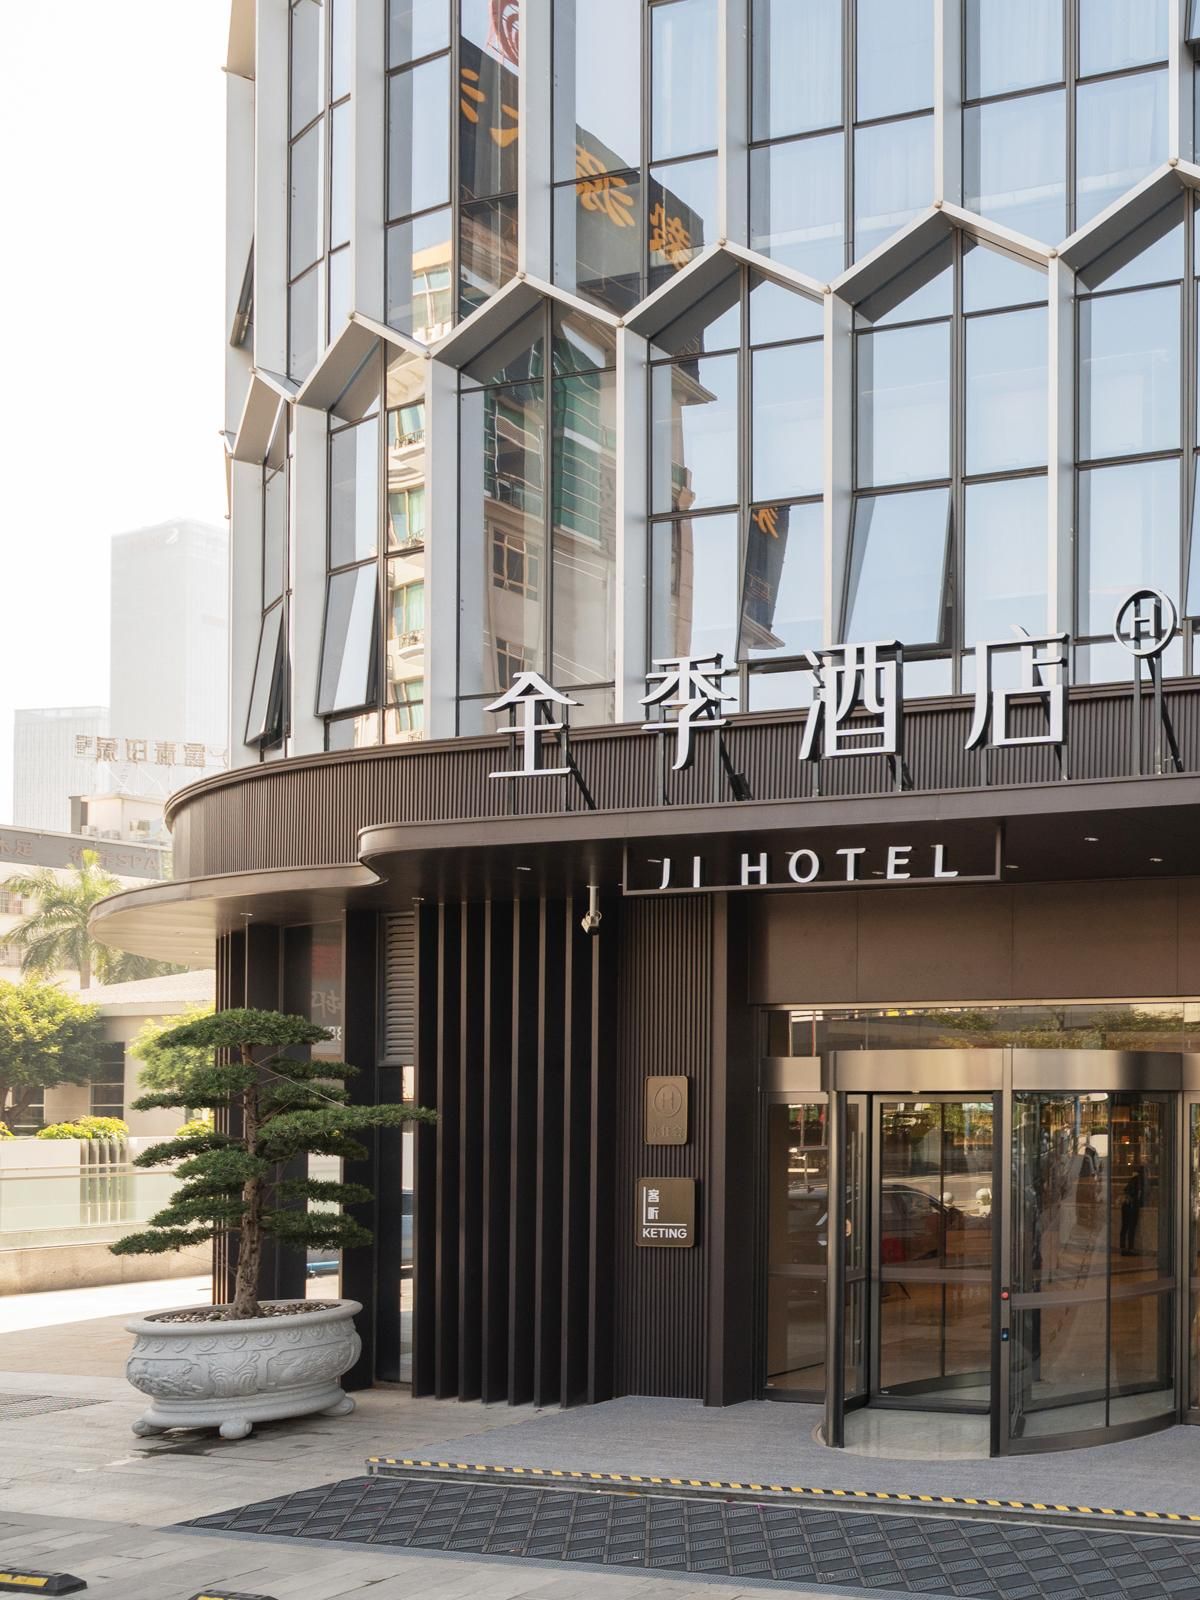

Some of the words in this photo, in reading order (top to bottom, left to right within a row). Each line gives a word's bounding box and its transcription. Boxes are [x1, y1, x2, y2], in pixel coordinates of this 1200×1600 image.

[483, 625, 1068, 778] 全季酒店
[659, 856, 700, 890] JI
[741, 844, 959, 886] HOTEL
[642, 1227, 688, 1239] KETING
